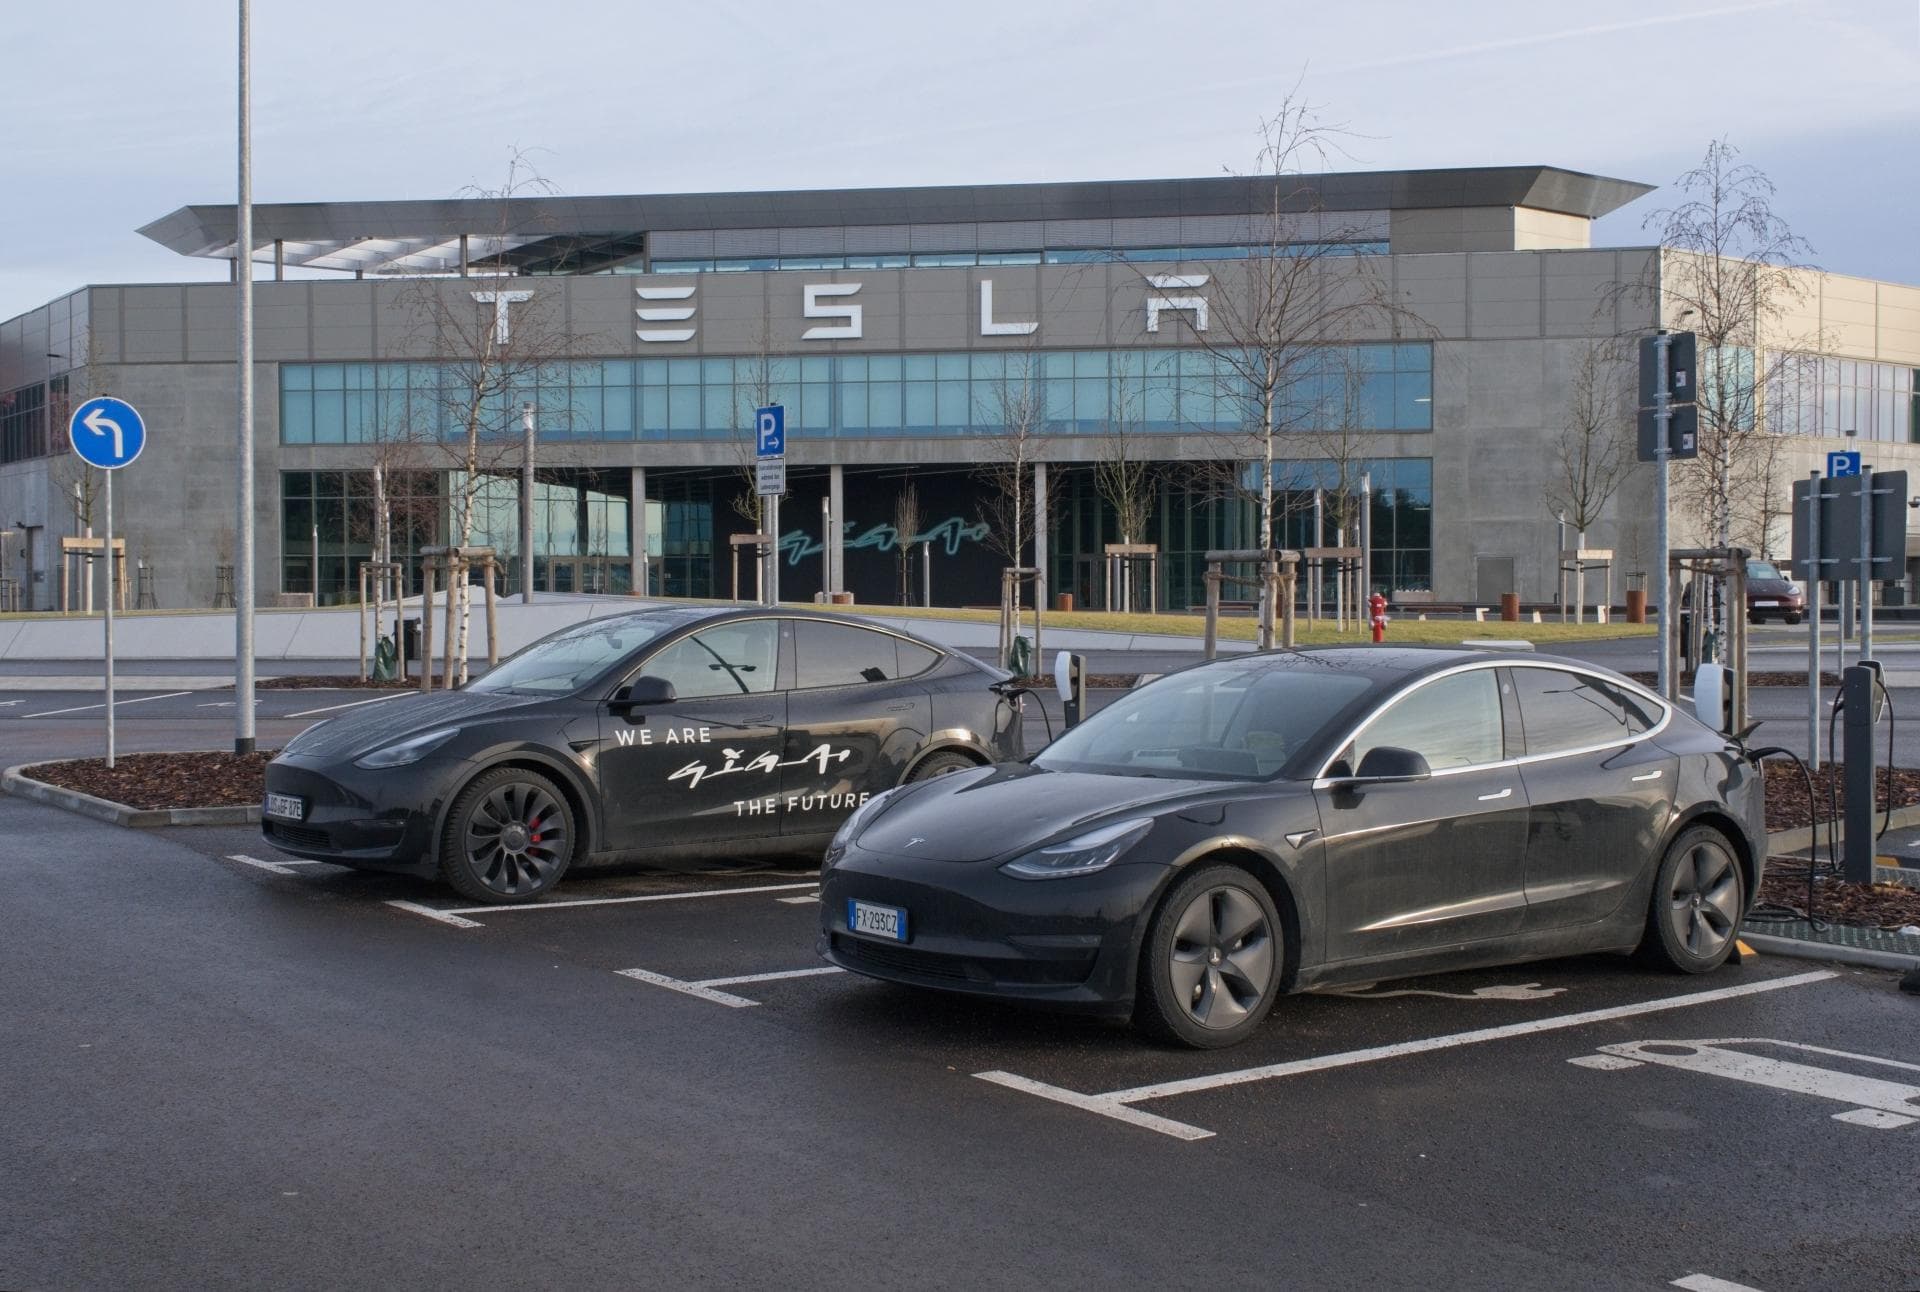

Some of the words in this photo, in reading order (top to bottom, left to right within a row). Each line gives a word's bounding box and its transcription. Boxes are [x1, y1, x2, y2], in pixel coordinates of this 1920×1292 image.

[469, 273, 1211, 345] TESLA
[760, 412, 776, 450] P
[1832, 455, 1850, 477] P
[615, 729, 653, 746] WE
[666, 727, 712, 744] ARE
[733, 798, 776, 816] THE
[787, 792, 870, 812] FUTURE
[869, 911, 897, 933] 293CZ
